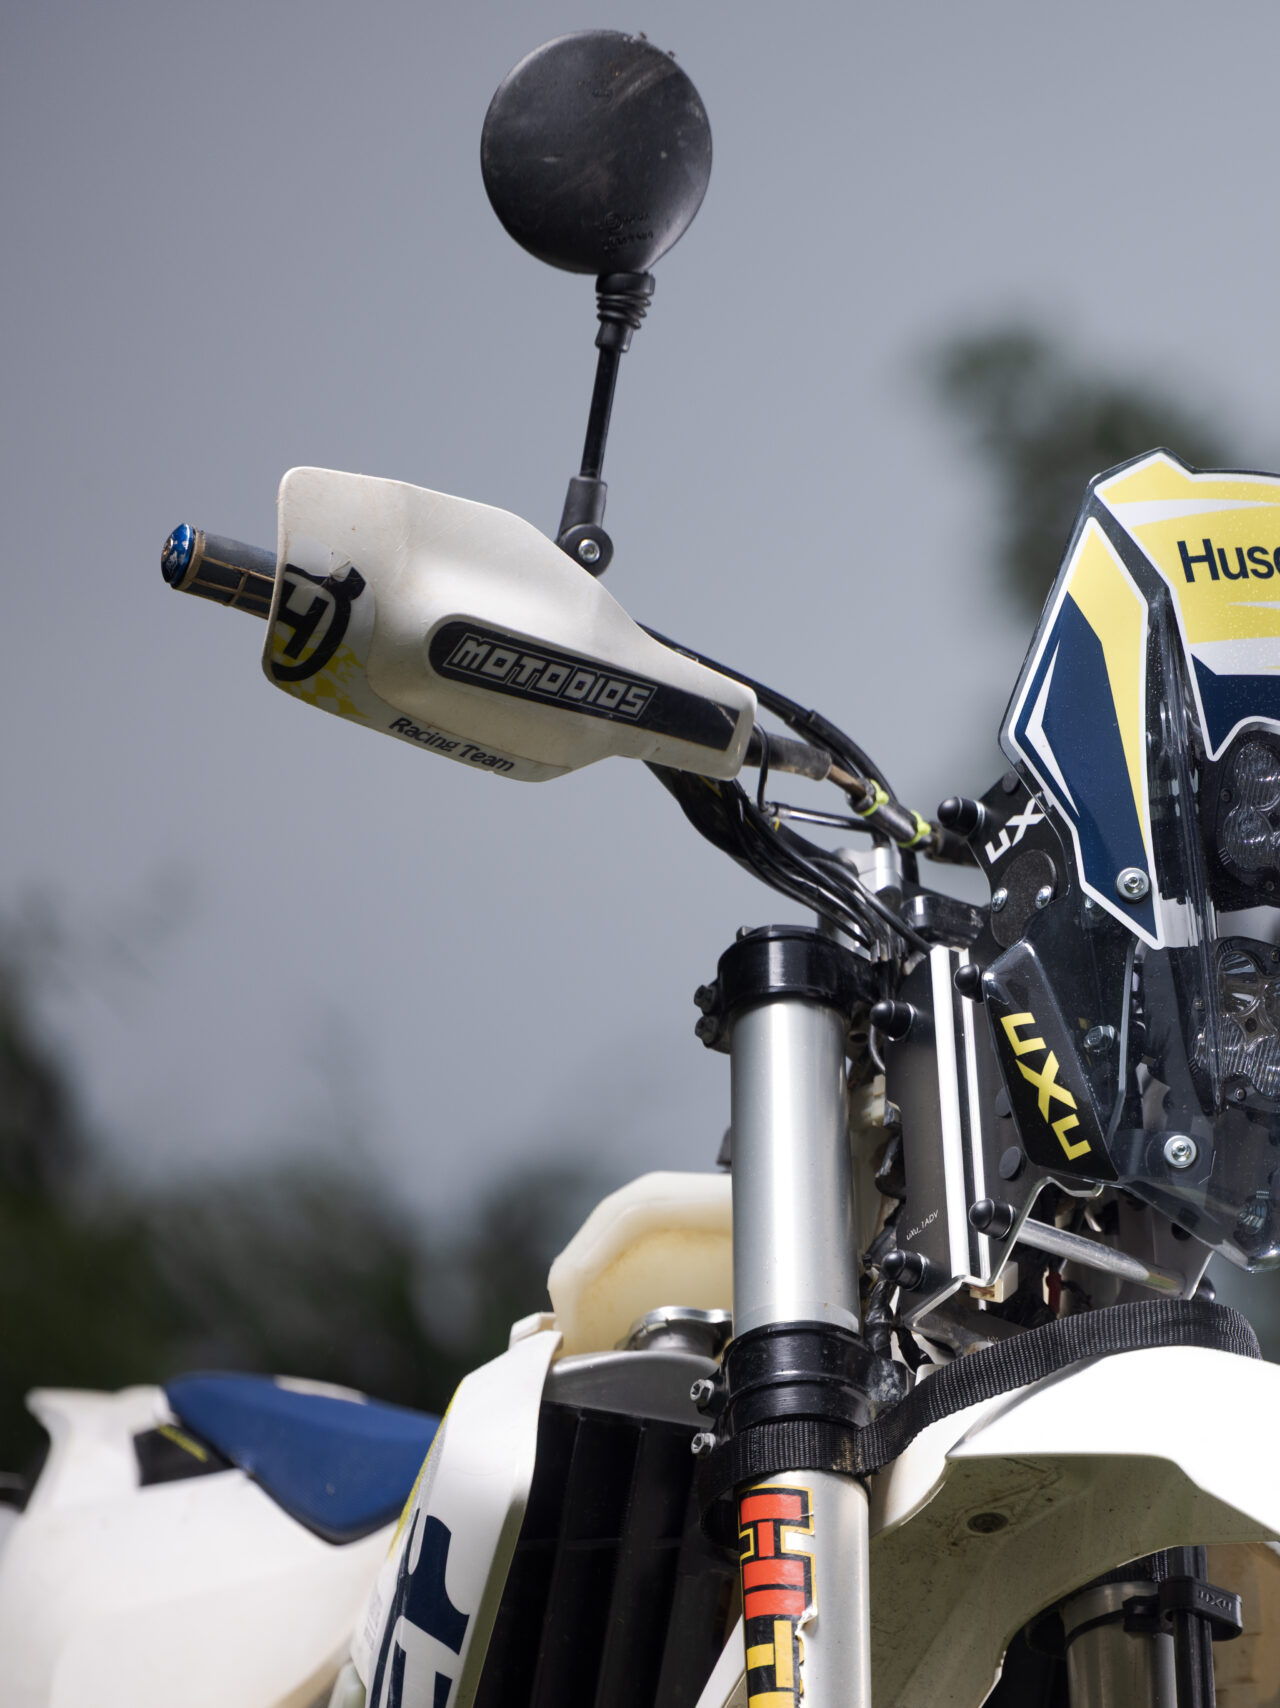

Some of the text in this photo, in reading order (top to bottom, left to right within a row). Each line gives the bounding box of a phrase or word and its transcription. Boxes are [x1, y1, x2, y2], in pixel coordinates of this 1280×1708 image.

[451, 638, 652, 716] MOTODIOS
[388, 717, 515, 772] Racing Team
